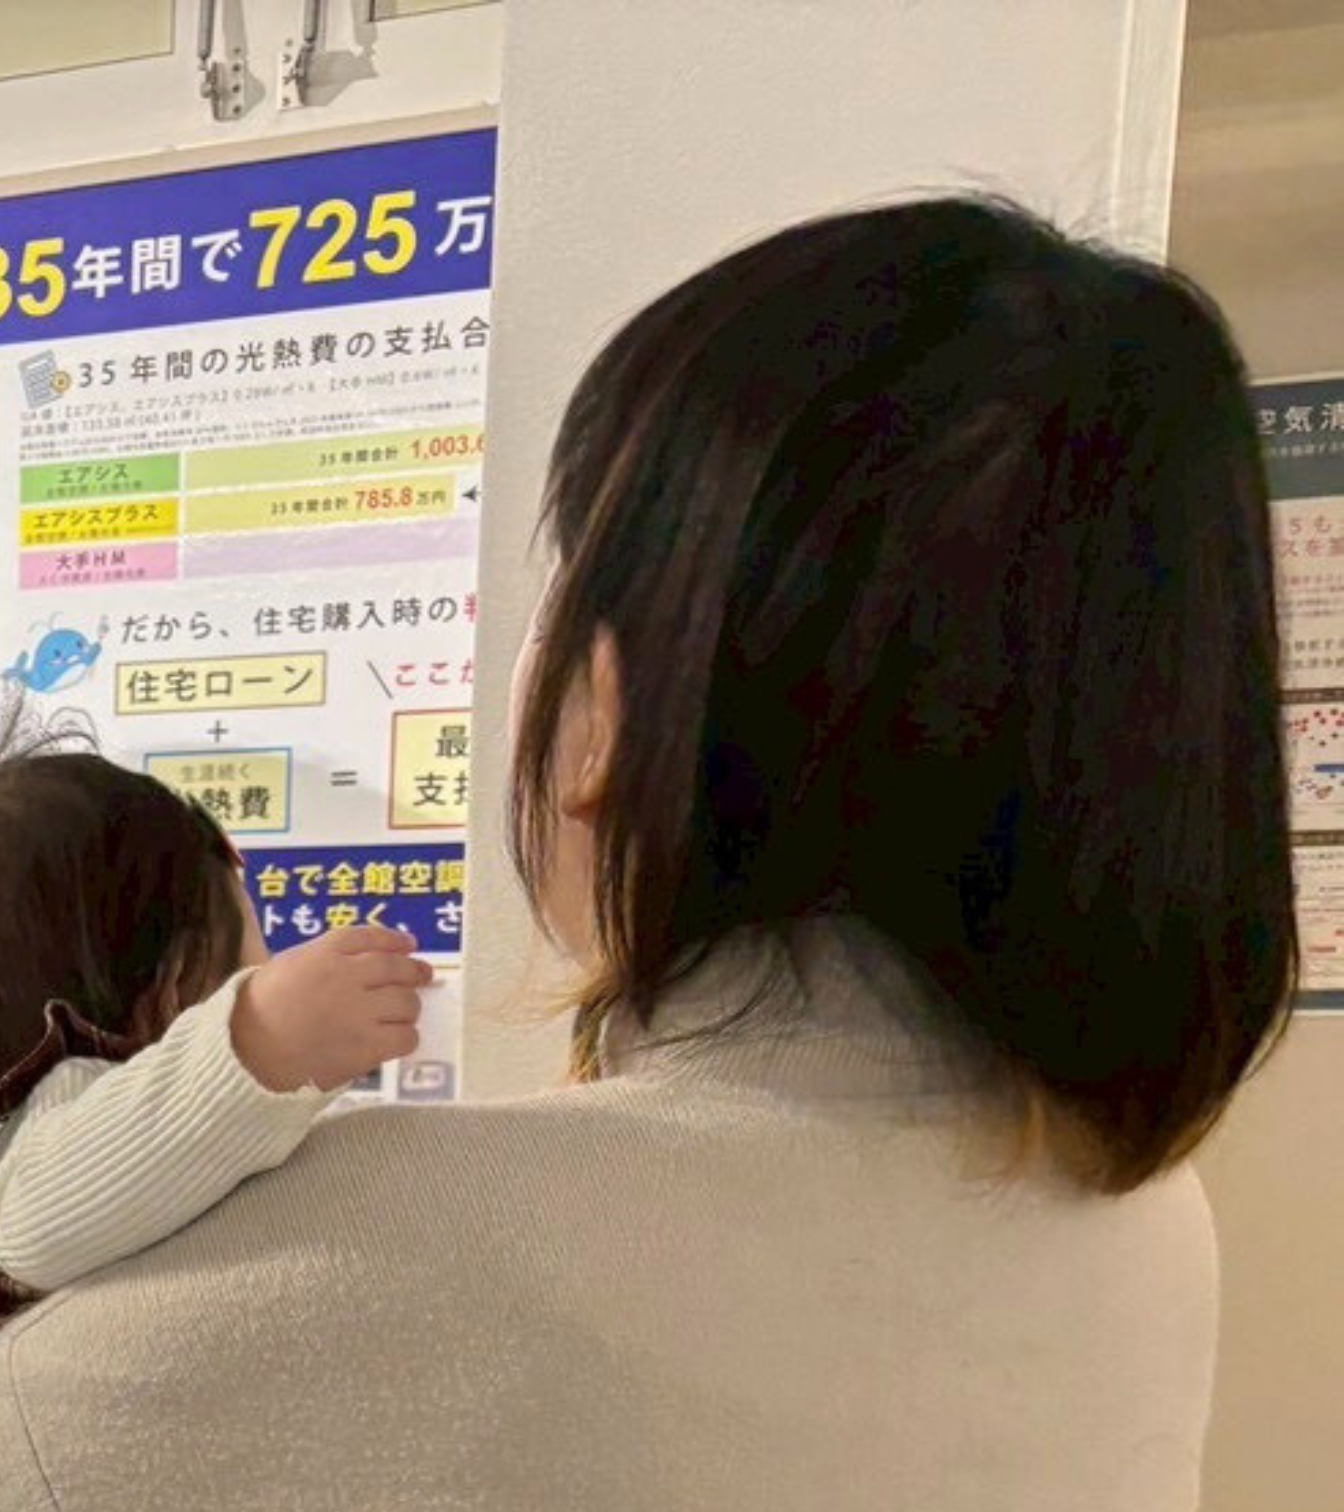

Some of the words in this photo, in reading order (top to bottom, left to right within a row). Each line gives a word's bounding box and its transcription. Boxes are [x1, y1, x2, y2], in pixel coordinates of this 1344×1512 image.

[58, 463, 128, 484] エアシス
[32, 504, 159, 528] エアシスプラス
[126, 665, 315, 705] 住宅ローン
[175, 785, 273, 820] 熱費
